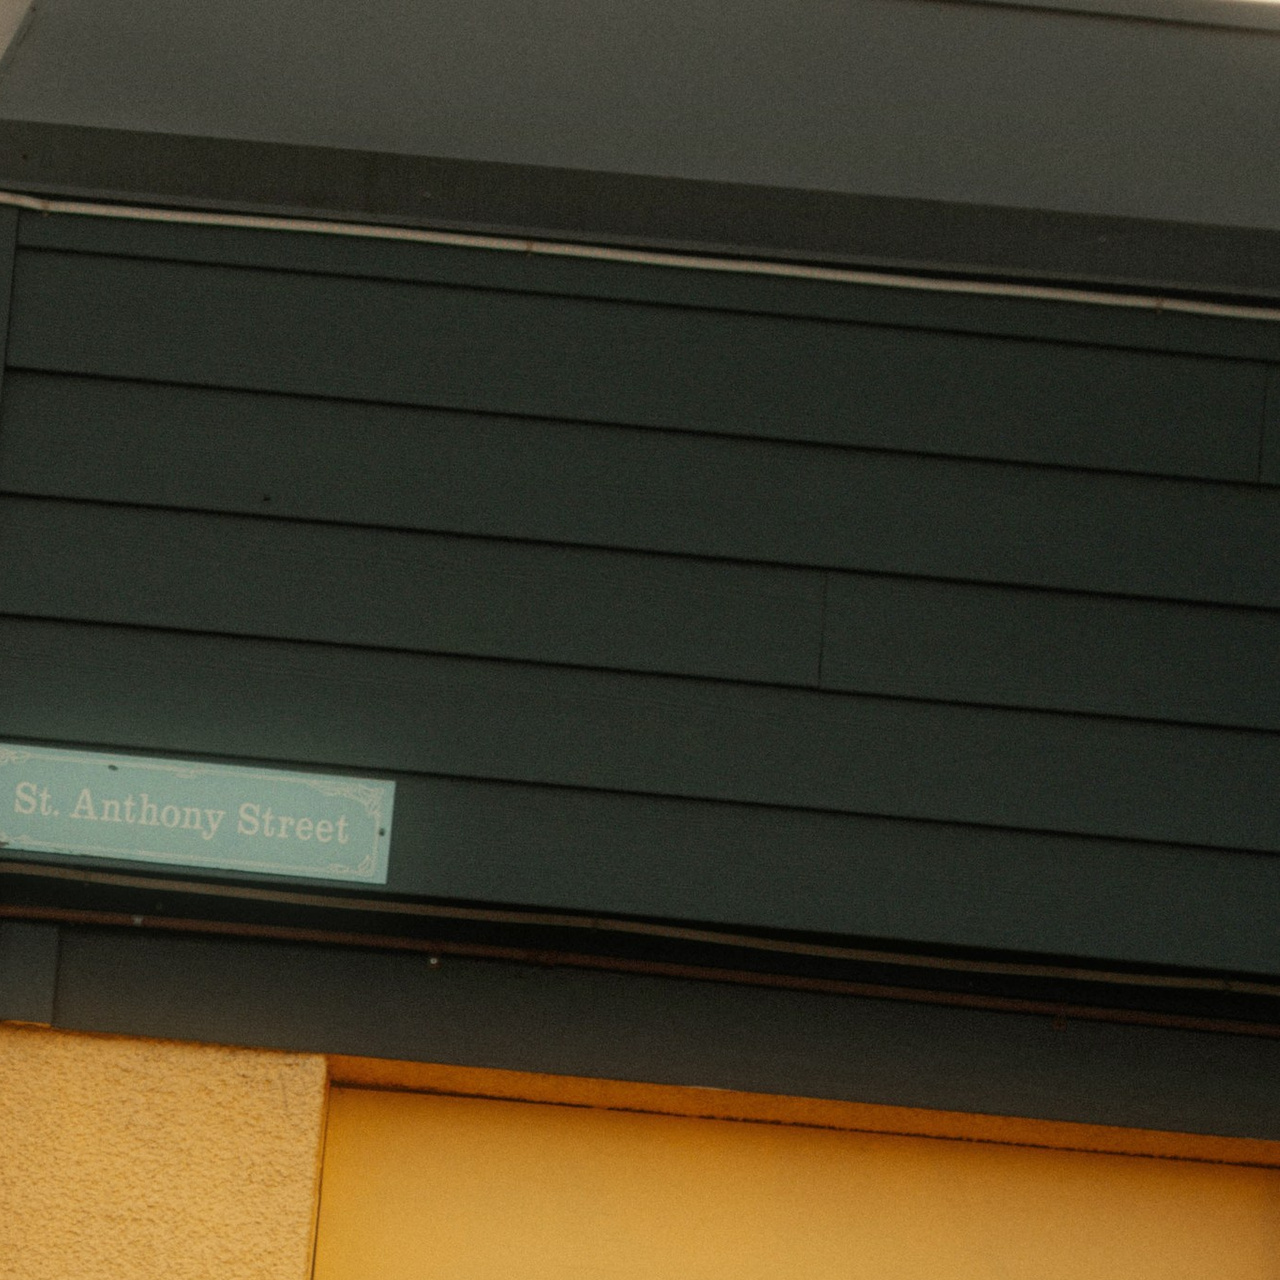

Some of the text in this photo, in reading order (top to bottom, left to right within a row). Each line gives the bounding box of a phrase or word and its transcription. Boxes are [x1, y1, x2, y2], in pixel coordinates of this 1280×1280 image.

[13, 781, 350, 845] St. Anthony Street
